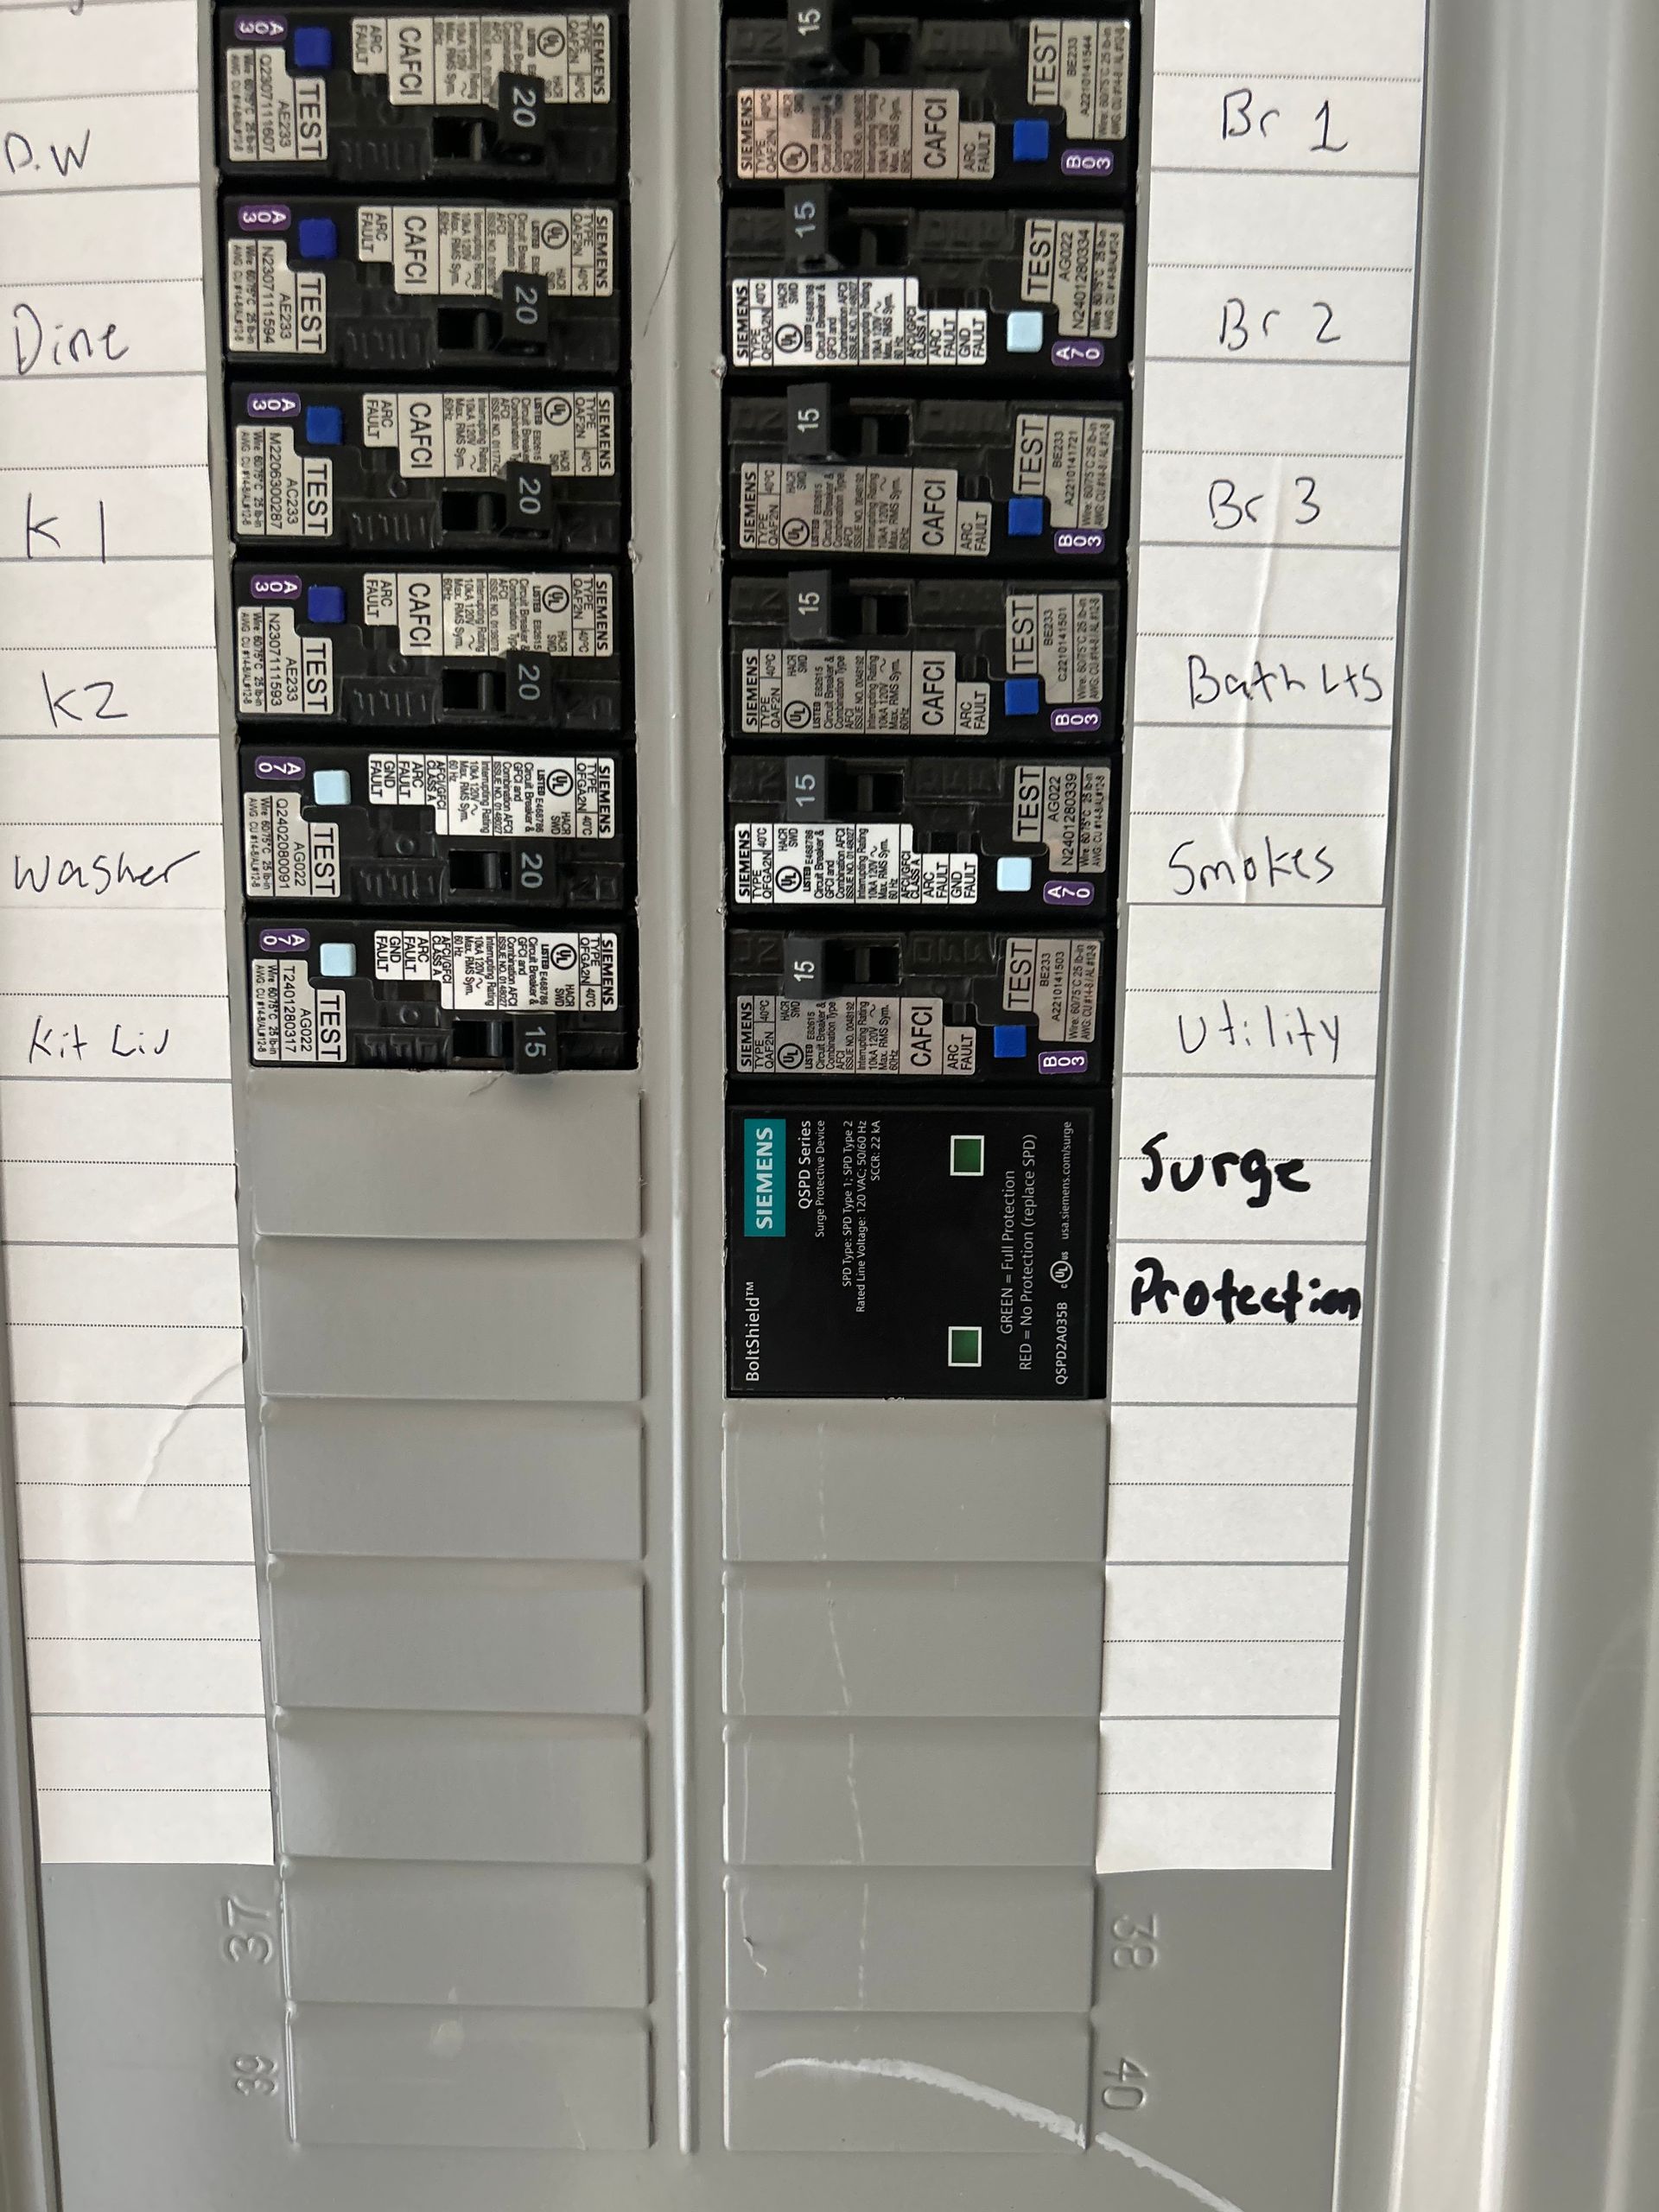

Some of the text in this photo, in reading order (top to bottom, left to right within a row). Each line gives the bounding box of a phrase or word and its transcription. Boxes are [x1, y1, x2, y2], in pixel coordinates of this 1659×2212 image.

[798, 7, 822, 36] 15
[399, 28, 421, 96] CAFCI
[593, 22, 605, 95] SIEMENS
[1033, 24, 1056, 101] TEST
[1067, 38, 1077, 76] BE233
[278, 100, 290, 148] AE233
[299, 84, 321, 158] TEST
[512, 86, 536, 128] 20
[741, 97, 752, 170] SIEMENS
[925, 98, 947, 168] CAFCI
[1219, 86, 1281, 143] Br
[795, 201, 816, 238] 15
[404, 216, 427, 284] CAFCI
[596, 216, 608, 289] SIEMENS
[1027, 222, 1050, 295] TEST
[1060, 232, 1072, 281] AG022
[280, 293, 291, 340] AE233
[301, 278, 321, 350] TEST
[515, 286, 538, 324] 20
[737, 286, 747, 358] SIEMENS
[1218, 302, 1343, 351] Br 2
[14, 302, 130, 376] Dine
[410, 404, 430, 469] CAFCI
[600, 400, 610, 469] SIEMENS
[798, 409, 819, 432] 15
[1019, 420, 1043, 491] TEST
[1052, 431, 1064, 467] BE233
[270, 432, 282, 529] M2206300287
[287, 478, 298, 524] AC233
[308, 464, 327, 534] TEST
[519, 477, 540, 514] 20
[744, 472, 755, 543] SIEMENS
[1208, 476, 1321, 529] Br 3
[922, 480, 945, 546] CAFCI
[410, 583, 430, 647] CAFCI
[597, 581, 607, 651] SIEMENS
[798, 592, 819, 614] 15
[1044, 609, 1052, 645] BE233
[270, 613, 281, 706] N2307111593
[1012, 601, 1033, 671] TEST
[286, 658, 297, 702] AE233
[307, 643, 327, 712] TEST
[519, 664, 540, 701] 20
[746, 657, 757, 726] SIEMENS
[923, 661, 944, 725] CAFCI
[1187, 655, 1308, 705] Bath
[600, 766, 610, 833] SIEMENS
[796, 774, 816, 807] 15
[1018, 767, 1039, 836] TEST
[1048, 776, 1060, 822] AG022
[276, 798, 289, 888] Q2402080091
[1061, 773, 1077, 866] N2401280339
[14, 850, 200, 896] Washer
[295, 842, 305, 887] AG022
[315, 828, 335, 895] TEST
[521, 853, 543, 888] 20
[739, 830, 749, 896] SIEMENS
[753, 870, 762, 899] TYPE
[762, 852, 772, 899] QFGA2N
[1167, 844, 1335, 894] Smokes
[378, 937, 388, 971] FAULT
[390, 937, 400, 963] GND
[405, 937, 416, 972] FAULT
[418, 938, 428, 963] ARC
[581, 938, 590, 984] QFGA2N
[591, 938, 600, 966] TYPE
[602, 940, 613, 1005] SIEMENS
[793, 961, 814, 982] 15
[1008, 943, 1032, 1007] TEST
[1039, 953, 1050, 986] BE233
[284, 966, 296, 1052] T2401280317
[1052, 951, 1065, 1021] A2210141503
[30, 1014, 88, 1058] Kit
[301, 1008, 311, 1052] AG022
[321, 995, 340, 1060] TEST
[525, 1027, 545, 1057] 15
[741, 1002, 752, 1066] SIEMENS
[764, 1031, 773, 1069] QAF2N
[912, 1007, 931, 1066] CAFCI
[962, 1034, 972, 1070] FAULT
[1178, 1001, 1344, 1064] Utility
[948, 1045, 957, 1069] ARC
[798, 1121, 813, 1209] QSPD Series
[844, 1130, 854, 1153] Type
[844, 1156, 853, 1175] SPD
[871, 1121, 880, 1180] SCCR: 22 kA
[1022, 1135, 1037, 1166] SPD)
[756, 1128, 773, 1229] SIEMENS
[816, 1121, 826, 1237] Surge Protective Device
[1061, 1122, 1072, 1239] usa.siemens.com/surge
[1140, 1130, 1311, 1209] Surge
[843, 1191, 854, 1213] Type
[843, 1216, 852, 1236] SPD
[856, 1121, 868, 1312] Rated Line Voltage: 120 VAC; 50/60 Hz
[1002, 1171, 1015, 1241] Protection
[1020, 1171, 1037, 1226] (replace
[843, 1238, 853, 1264] Type:
[843, 1267, 852, 1287] SPD
[1001, 1246, 1014, 1269] Full
[1020, 1232, 1034, 1301] Protection
[1001, 1288, 1014, 1334] GREEN
[1020, 1306, 1033, 1325] No
[1130, 1255, 1362, 1325] Protection
[1020, 1344, 1032, 1370] RED
[1056, 1302, 1068, 1384] QSPD2A035B
[226, 1895, 273, 1966] 37
[1113, 1912, 1159, 1970] 38
[236, 2055, 278, 2096] 39
[1103, 2056, 1149, 2110] 40
